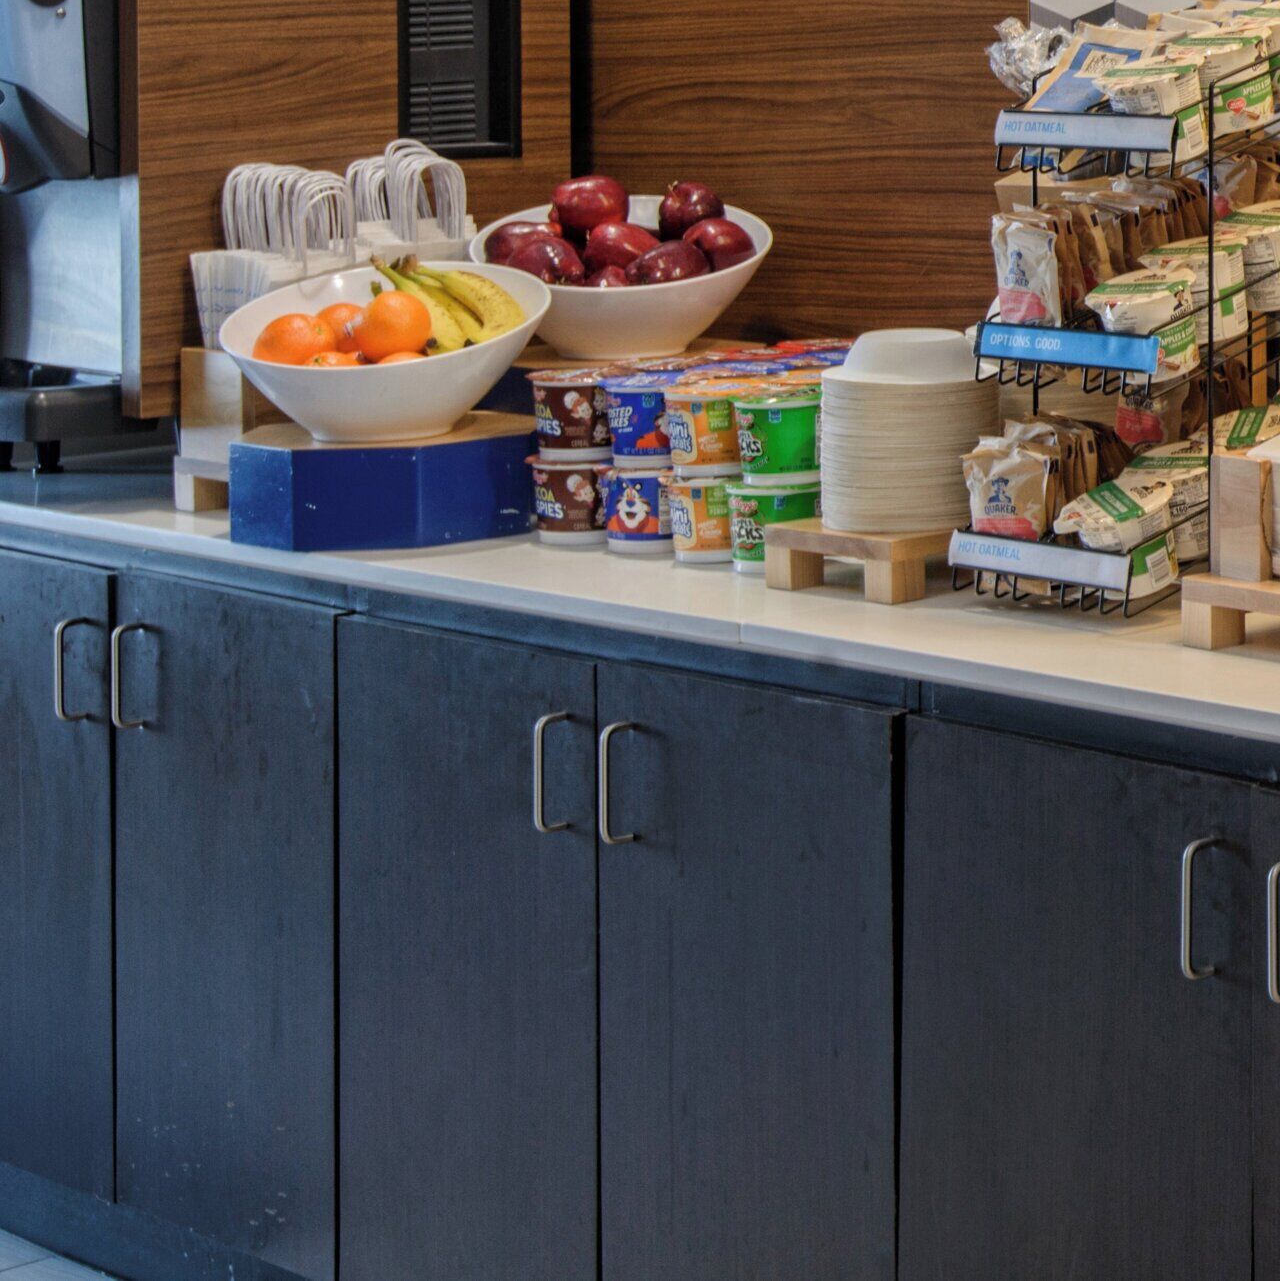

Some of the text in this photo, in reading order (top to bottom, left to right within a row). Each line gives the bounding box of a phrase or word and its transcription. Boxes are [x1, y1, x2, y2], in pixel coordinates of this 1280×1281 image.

[1004, 121, 1067, 134] HOT OATMEAL
[984, 504, 1017, 515] QUAKER
[957, 541, 1021, 560] HOT OATMEAL
